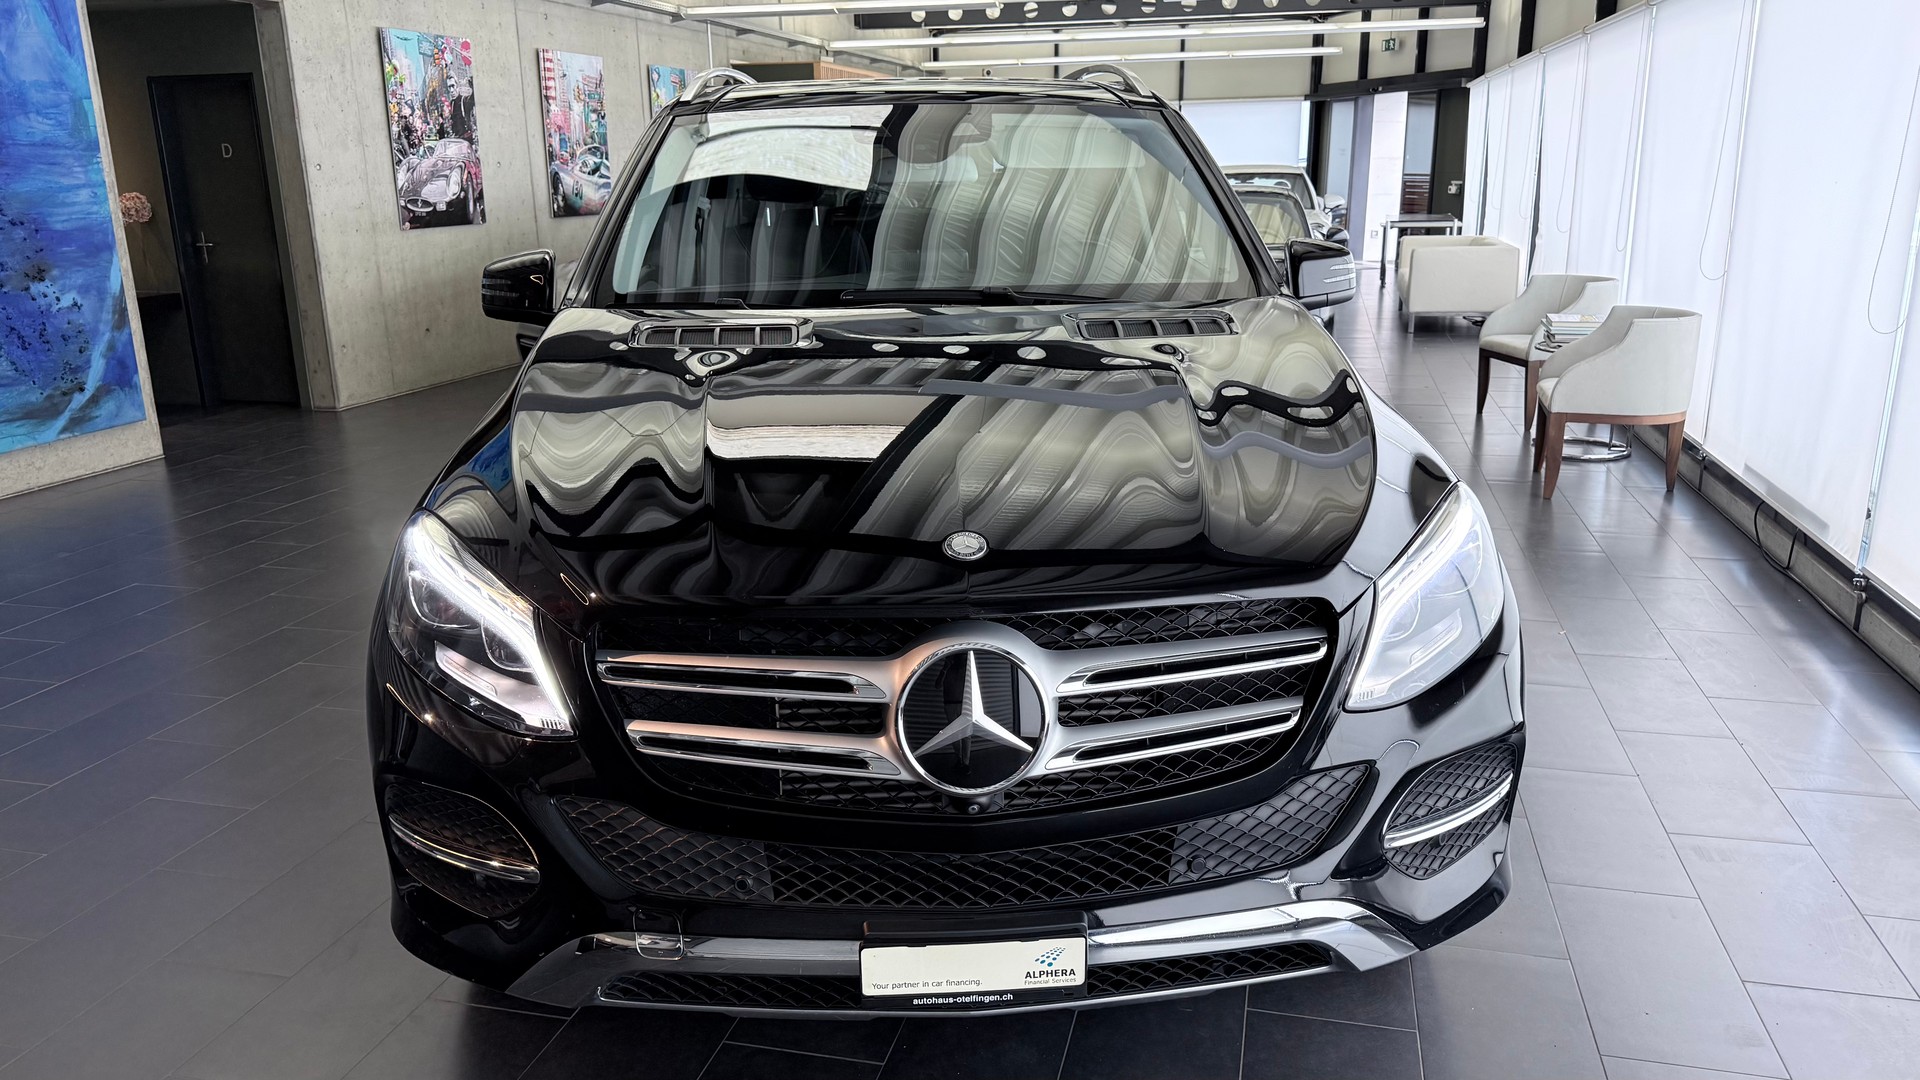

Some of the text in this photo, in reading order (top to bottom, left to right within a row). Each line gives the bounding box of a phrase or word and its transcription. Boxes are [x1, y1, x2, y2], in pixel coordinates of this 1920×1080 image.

[221, 143, 232, 158] D
[1024, 968, 1076, 979] ALPHERA
[891, 982, 920, 990] partner
[945, 978, 983, 987] financing.
[913, 993, 1013, 1005] autohaus-otelfingen.ch
